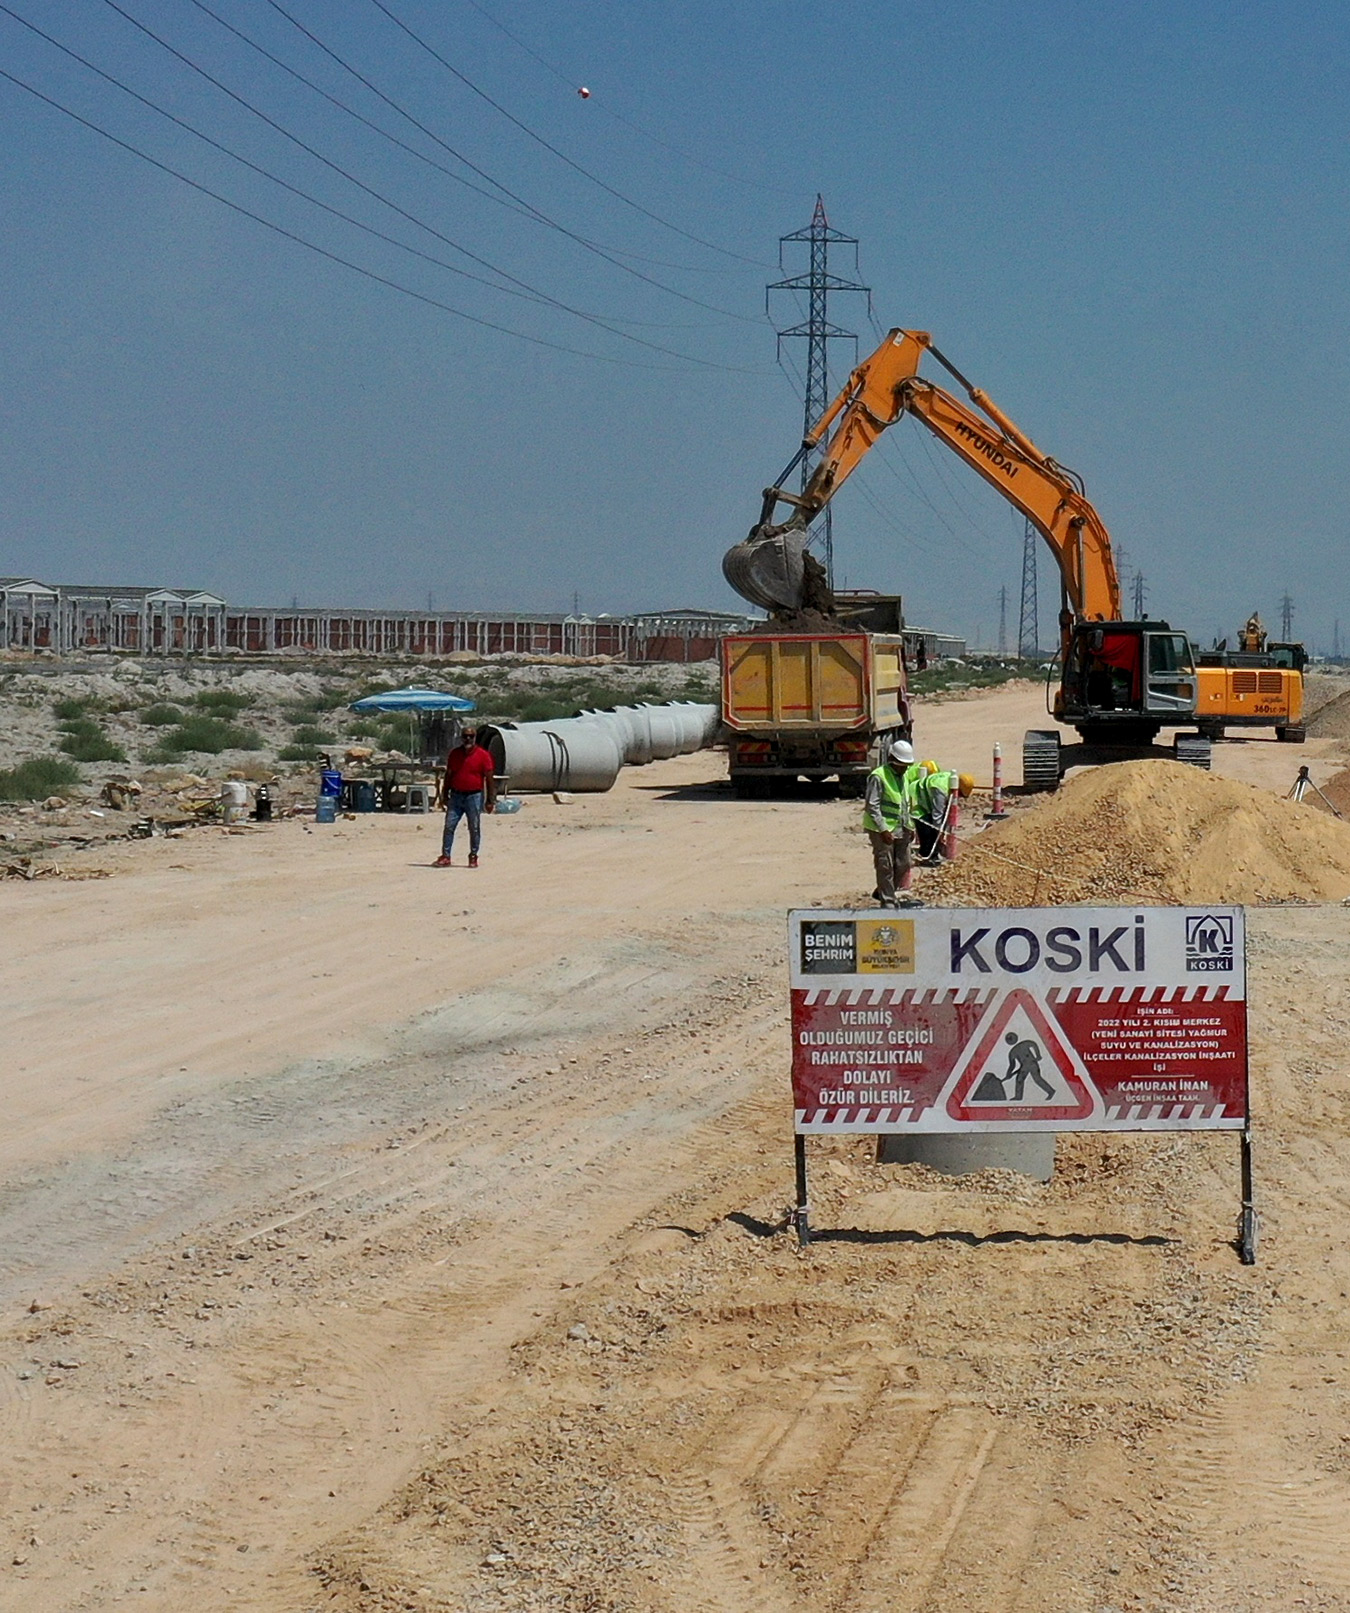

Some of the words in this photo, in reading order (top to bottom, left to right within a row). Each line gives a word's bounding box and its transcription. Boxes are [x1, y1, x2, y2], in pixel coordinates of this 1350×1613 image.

[954, 421, 1019, 479] HYUNDAI
[805, 933, 853, 947] BENİM
[950, 915, 1145, 973] KOSKİ
[805, 948, 853, 962] ŞEHRİM
[1190, 958, 1230, 970] KOSKİ
[840, 1008, 893, 1028] VERMİŞ
[1098, 1019, 1120, 1027] 2022
[1182, 1018, 1221, 1026] MERKEZ
[800, 1028, 884, 1045] OLDUĞUMUZ
[888, 1027, 934, 1048] GEÇİCİ
[1091, 1030, 1117, 1039] (YENİ
[1119, 1029, 1154, 1038] SANAYİ
[1156, 1029, 1186, 1037] SİTESİ
[1188, 1028, 1227, 1037] YAĞMUR
[1143, 1041, 1219, 1049] KANALİZASYON)
[811, 1050, 923, 1065] RAHATSIZLIKTAN
[1083, 1052, 1122, 1061] İLÇELER
[1124, 1052, 1196, 1060] KANALİZASYON
[1198, 1051, 1236, 1060] İNŞAATI
[1153, 1063, 1166, 1072] İŞİ
[843, 1070, 891, 1084] DOLAYI
[1117, 1081, 1177, 1091] KAMURAN
[1179, 1079, 1209, 1091] İNAN
[819, 1088, 855, 1104] ÖZÜR
[860, 1086, 915, 1104] DİLERİZ.
